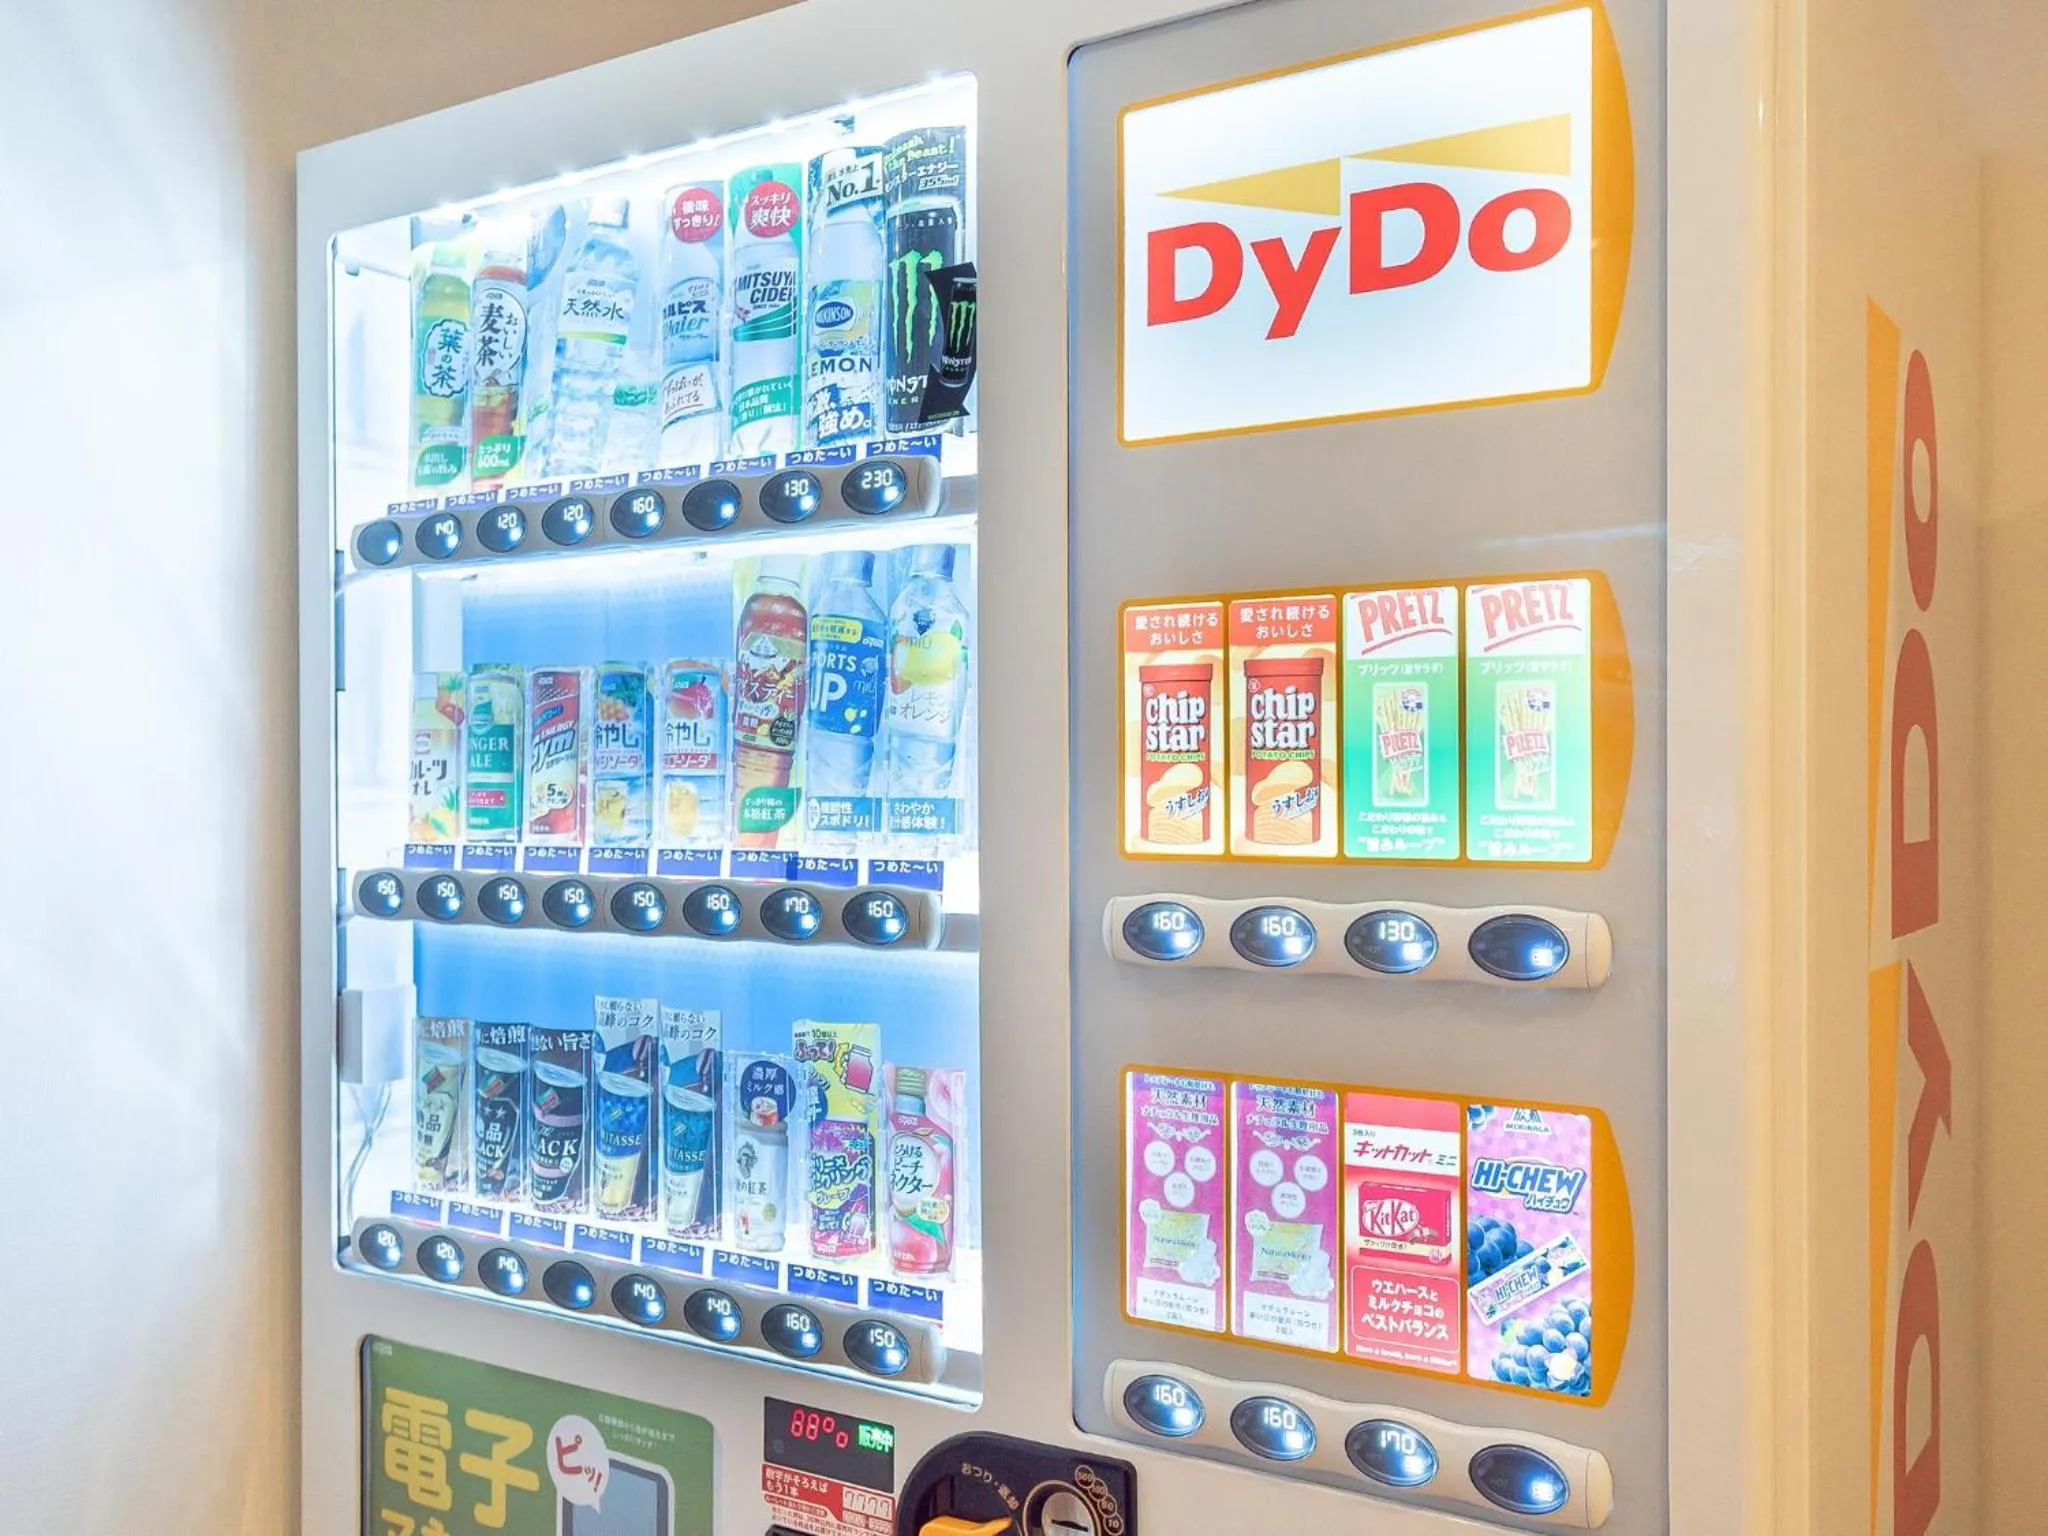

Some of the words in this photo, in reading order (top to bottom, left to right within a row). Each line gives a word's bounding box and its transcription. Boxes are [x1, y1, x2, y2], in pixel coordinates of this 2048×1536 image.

[750, 192, 792, 206] スッキリ
[751, 206, 792, 228] 爽快
[1147, 182, 1572, 340] DyDo
[564, 298, 625, 321] 天然水
[478, 303, 504, 367] 麦茶
[502, 311, 518, 360] おいしい
[432, 328, 464, 390] 葉の茶
[784, 479, 808, 497] 130
[862, 469, 892, 489] 230
[564, 504, 583, 521] 120
[633, 497, 654, 513] 160
[498, 512, 517, 529] 120
[1240, 604, 1330, 624] 愛され続ける
[1358, 588, 1444, 643] PRETZ
[1480, 584, 1573, 639] PRETZ
[1135, 612, 1219, 631] 愛され続ける
[1255, 622, 1313, 640] おいしさ
[1150, 629, 1204, 646] おいしさ
[899, 703, 951, 723] オレンジ
[1145, 690, 1206, 726] chip
[1250, 685, 1317, 722] chip
[1145, 724, 1206, 752] star
[1250, 721, 1317, 751] star
[378, 880, 396, 894] 150
[437, 882, 456, 897] 150
[499, 884, 518, 900] 150
[564, 887, 584, 904] 150
[634, 890, 655, 907] 150
[707, 894, 730, 910] 160
[785, 896, 809, 914] 170
[868, 900, 894, 918] 160
[1152, 912, 1184, 931] 160
[1261, 916, 1296, 935] 160
[1378, 919, 1416, 942] 130
[751, 1066, 779, 1081] 濃厚
[1257, 1096, 1316, 1116] 天然素材
[479, 1142, 504, 1159] ACK
[535, 1138, 579, 1156] ACK
[1354, 1140, 1432, 1164] キットカット
[1436, 1154, 1457, 1167] ミニ
[1474, 1159, 1582, 1196] HI-CHEW
[1526, 1194, 1571, 1211] ハイチュウ
[1370, 1199, 1415, 1235] KitKat
[377, 1230, 396, 1247] 120
[437, 1243, 456, 1260] 120
[499, 1255, 518, 1272] 140
[634, 1282, 655, 1300] 140
[1372, 1279, 1438, 1302] ウエハースと
[1495, 1269, 1540, 1303] HI-CHEW
[707, 1298, 730, 1316] 140
[1368, 1296, 1445, 1319] ミルクチョコの
[786, 1313, 810, 1331] 160
[1361, 1313, 1450, 1340] ベストバランス
[870, 1328, 895, 1347] 150
[1153, 1384, 1185, 1406] 160
[1263, 1407, 1296, 1430] 160
[858, 1424, 893, 1454] 販売中
[1381, 1429, 1416, 1454] 170
[381, 1386, 540, 1529] 電子
[555, 1434, 603, 1492] ピッ!
[766, 1467, 829, 1493] 数字がそろえば
[766, 1479, 800, 1497] もう1本
[1092, 1486, 1106, 1497] 100
[1101, 1501, 1114, 1511] 50
[1107, 1519, 1119, 1529] 10
